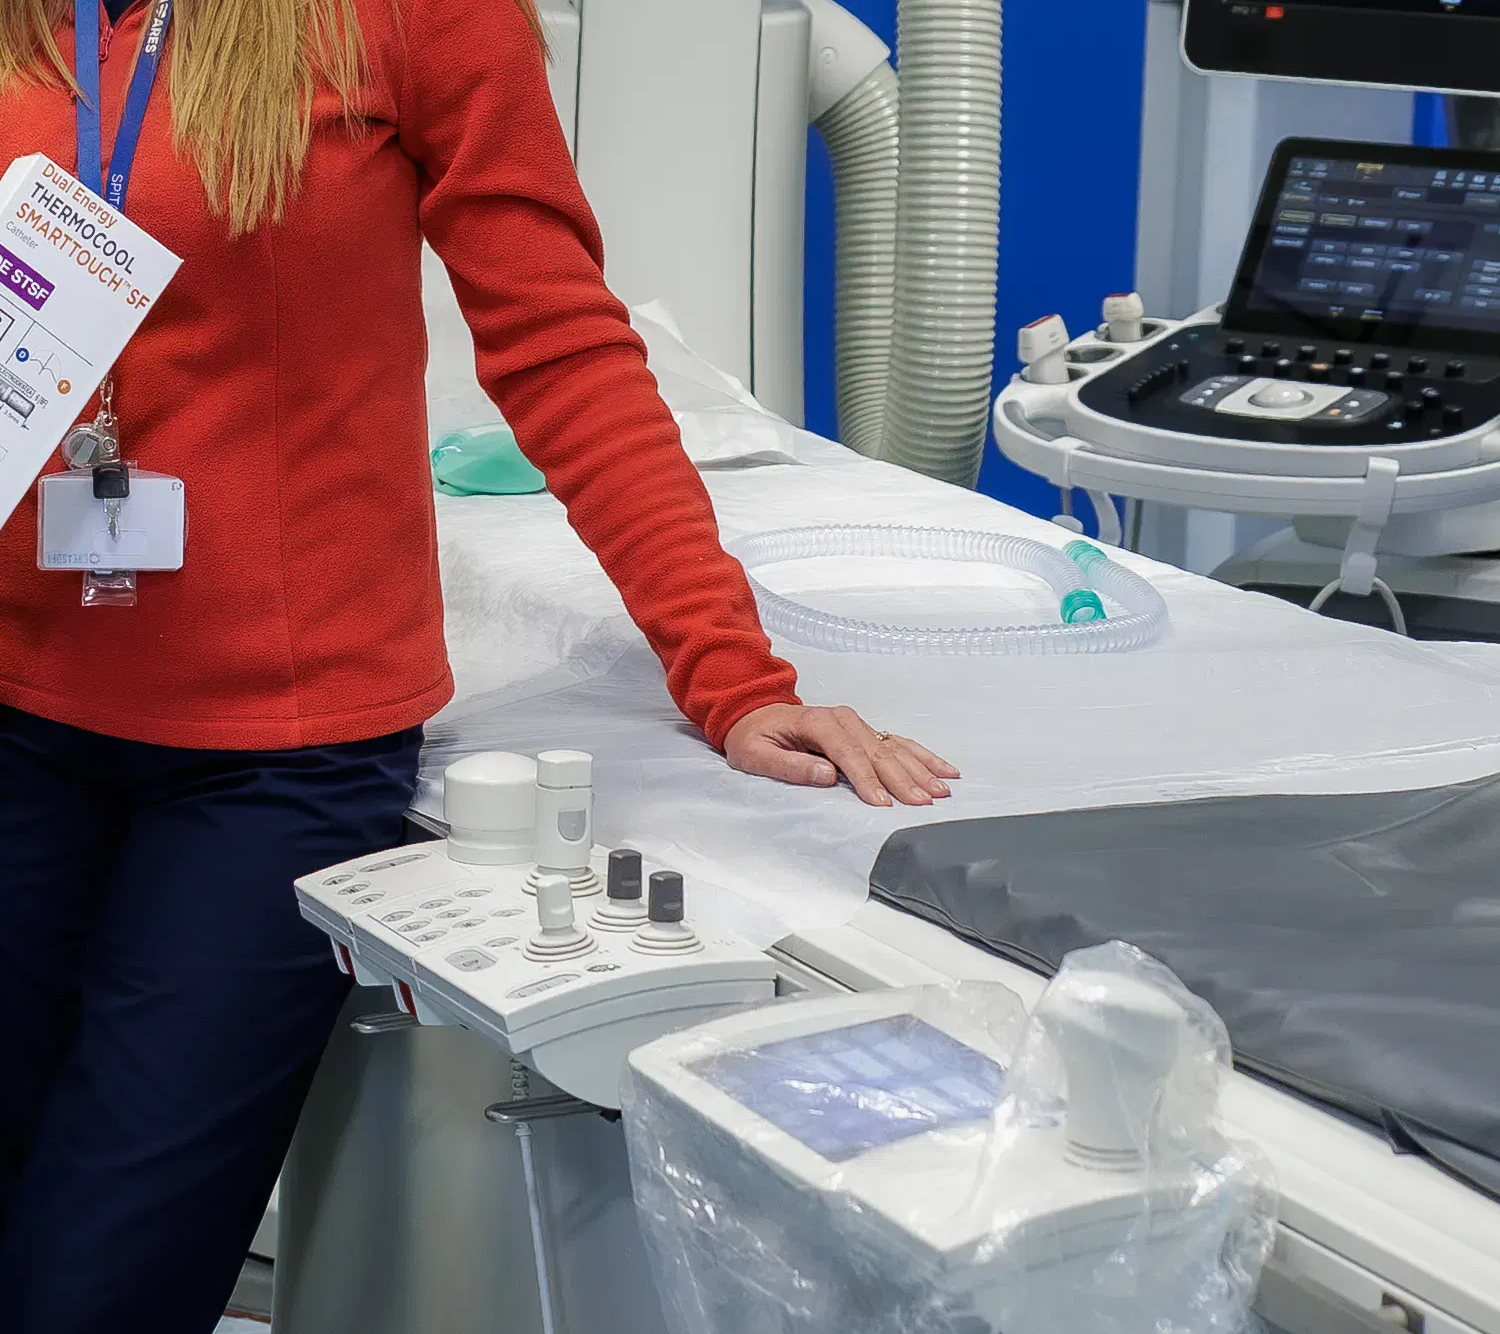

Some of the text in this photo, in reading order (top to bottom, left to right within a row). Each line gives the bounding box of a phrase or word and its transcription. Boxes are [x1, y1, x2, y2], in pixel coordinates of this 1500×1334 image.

[145, 19, 164, 54] ARES
[41, 164, 118, 229] Dual Energy
[5, 220, 39, 251] Catheter
[30, 181, 136, 275] THERMOCOOL
[10, 269, 50, 301] STSF
[125, 288, 151, 310] SF
